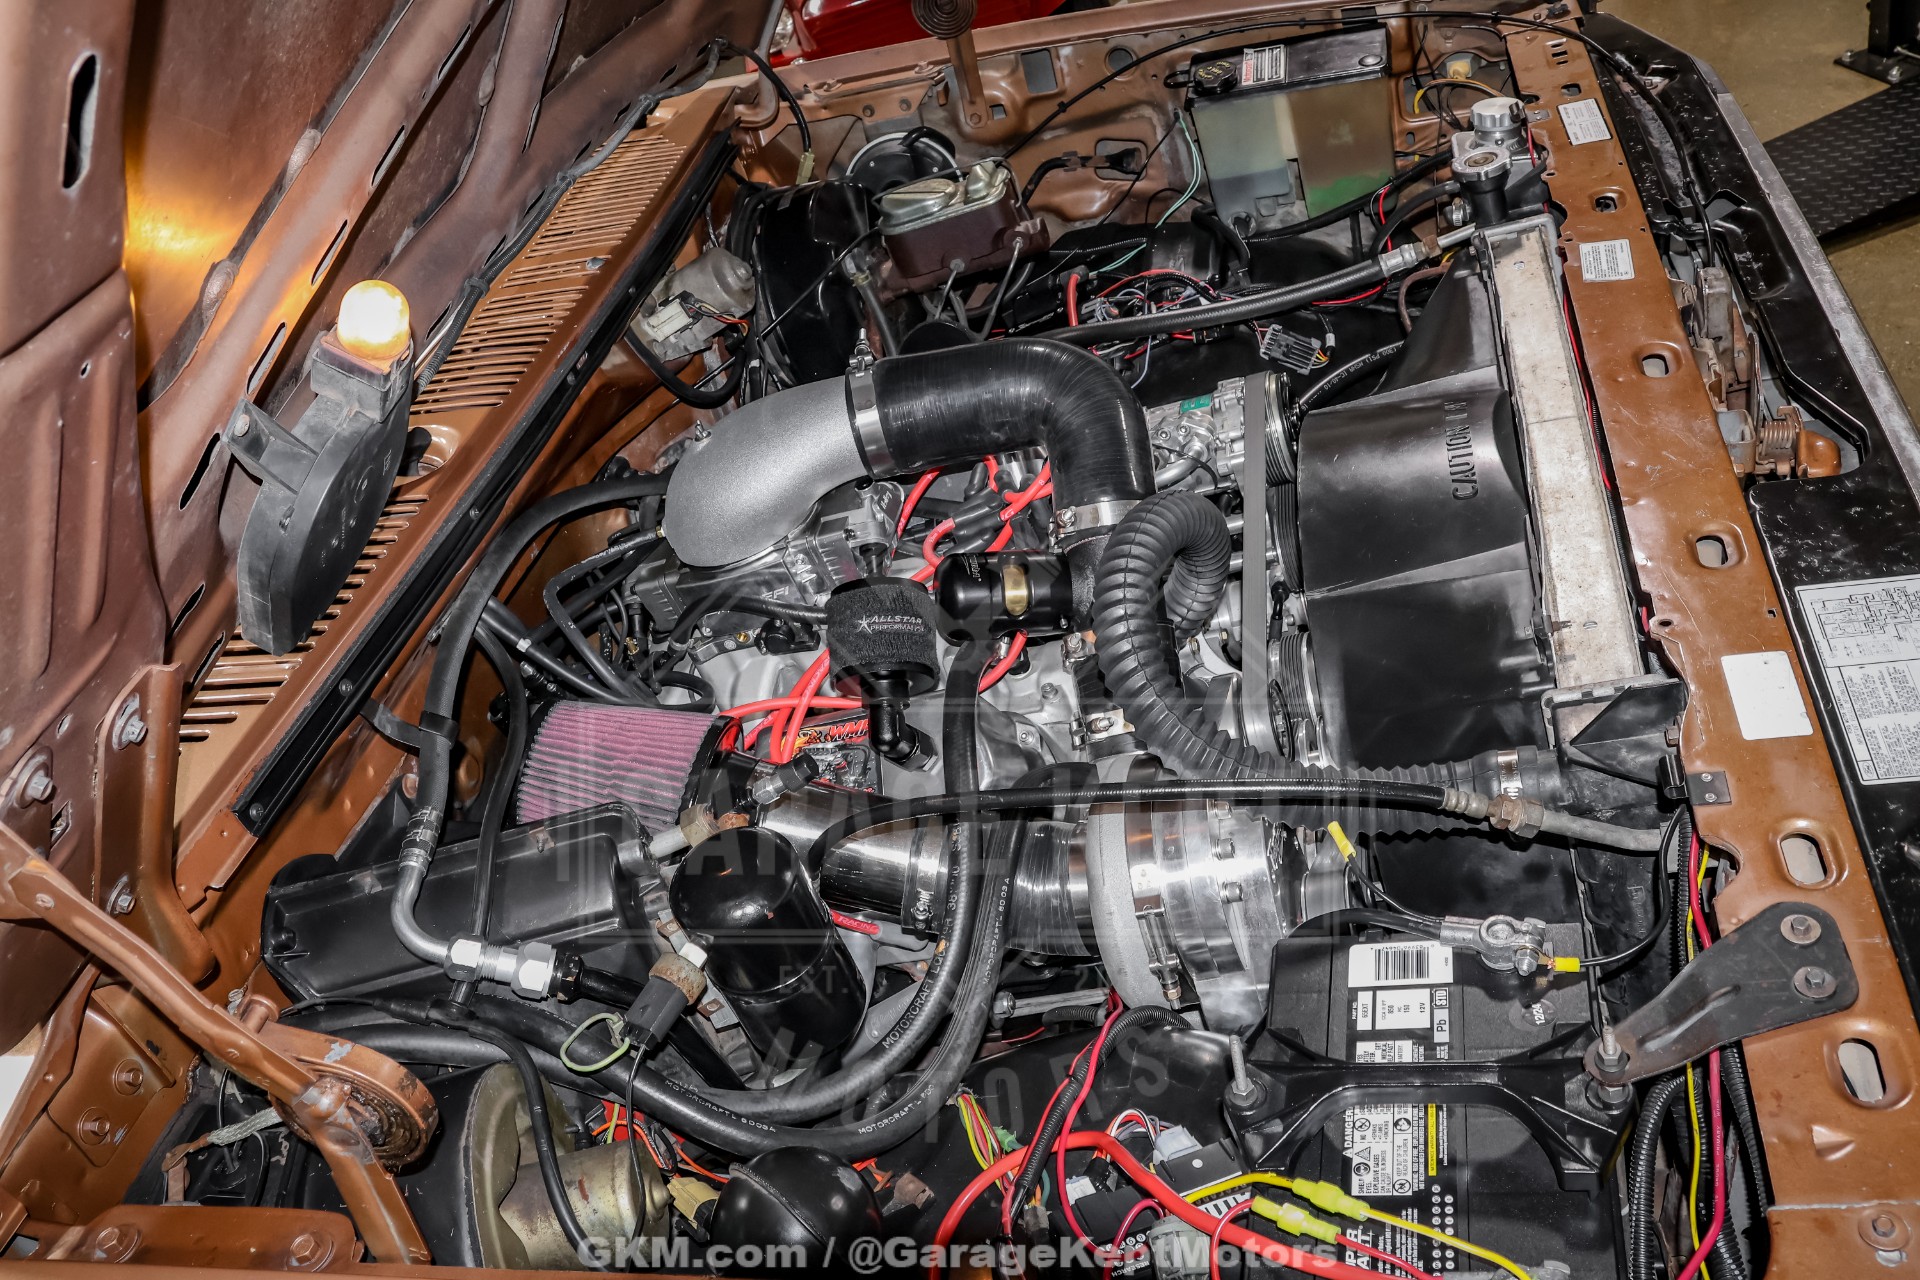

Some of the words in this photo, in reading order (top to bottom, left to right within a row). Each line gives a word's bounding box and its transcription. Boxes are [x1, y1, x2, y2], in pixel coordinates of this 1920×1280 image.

[1452, 422, 1478, 502] CAUTION
[870, 615, 922, 624] ALLSTAR
[1533, 1003, 1545, 1025] 12/24
[1437, 1019, 1447, 1032] Pb
[858, 1103, 915, 1135] MOTORCRAFT
[1344, 1109, 1353, 1147] DANGER
[1111, 1260, 1150, 1278] RESEARCH
